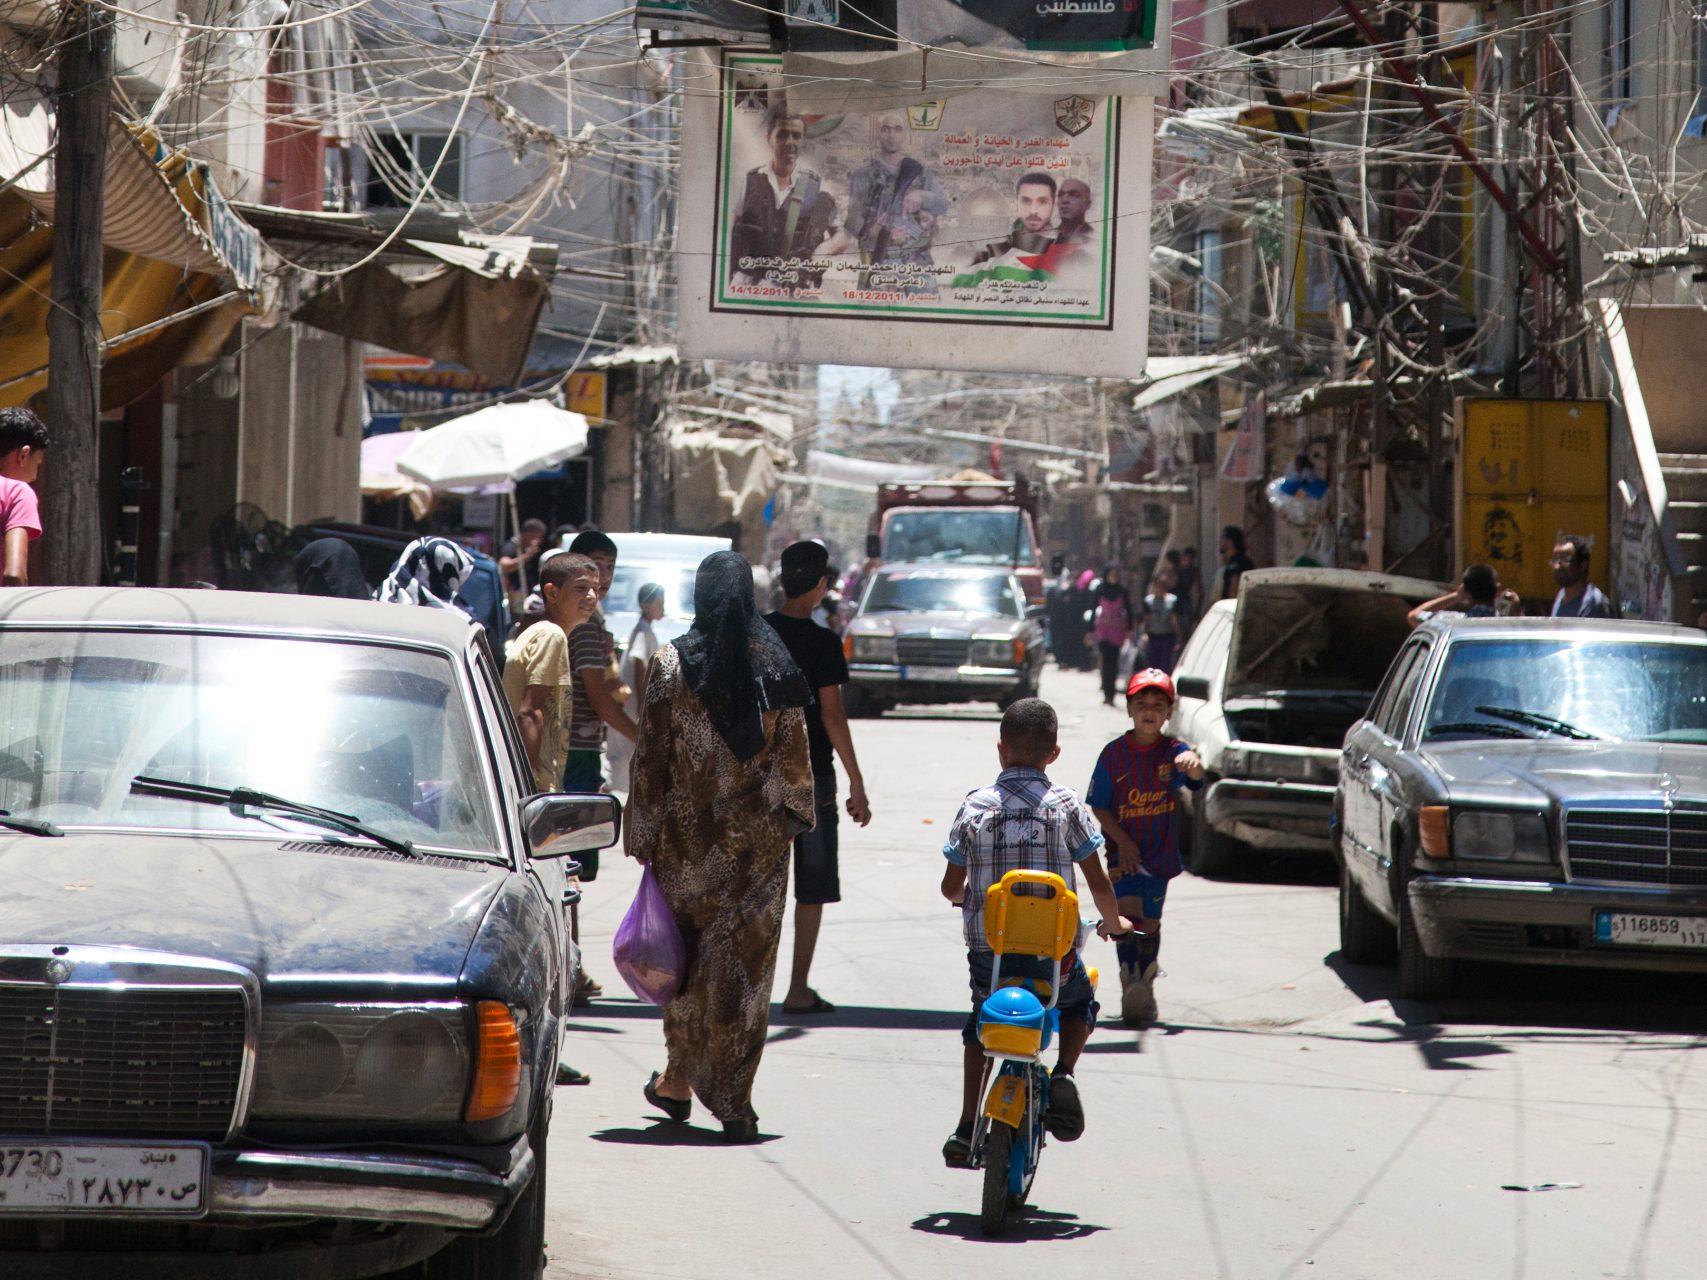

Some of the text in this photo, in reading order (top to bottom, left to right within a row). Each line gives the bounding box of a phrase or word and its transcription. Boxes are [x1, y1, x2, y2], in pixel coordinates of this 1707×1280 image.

[944, 133, 1070, 149] شهداء الغدر و الخيانة و العمالة
[1005, 157, 1023, 168] على
[1025, 156, 1045, 168] قتلوا
[1046, 158, 1069, 170] الذين
[801, 259, 833, 271] الشهيد
[836, 261, 869, 273] سليمان
[898, 263, 922, 275] مازن
[924, 264, 956, 276] الشهيد
[730, 286, 789, 297] 14/12/2011
[841, 290, 901, 301] 18/12/2011
[1000, 295, 1015, 305] حتى
[1619, 916, 1680, 934] 116859
[1681, 931, 1707, 945] ١١٦
